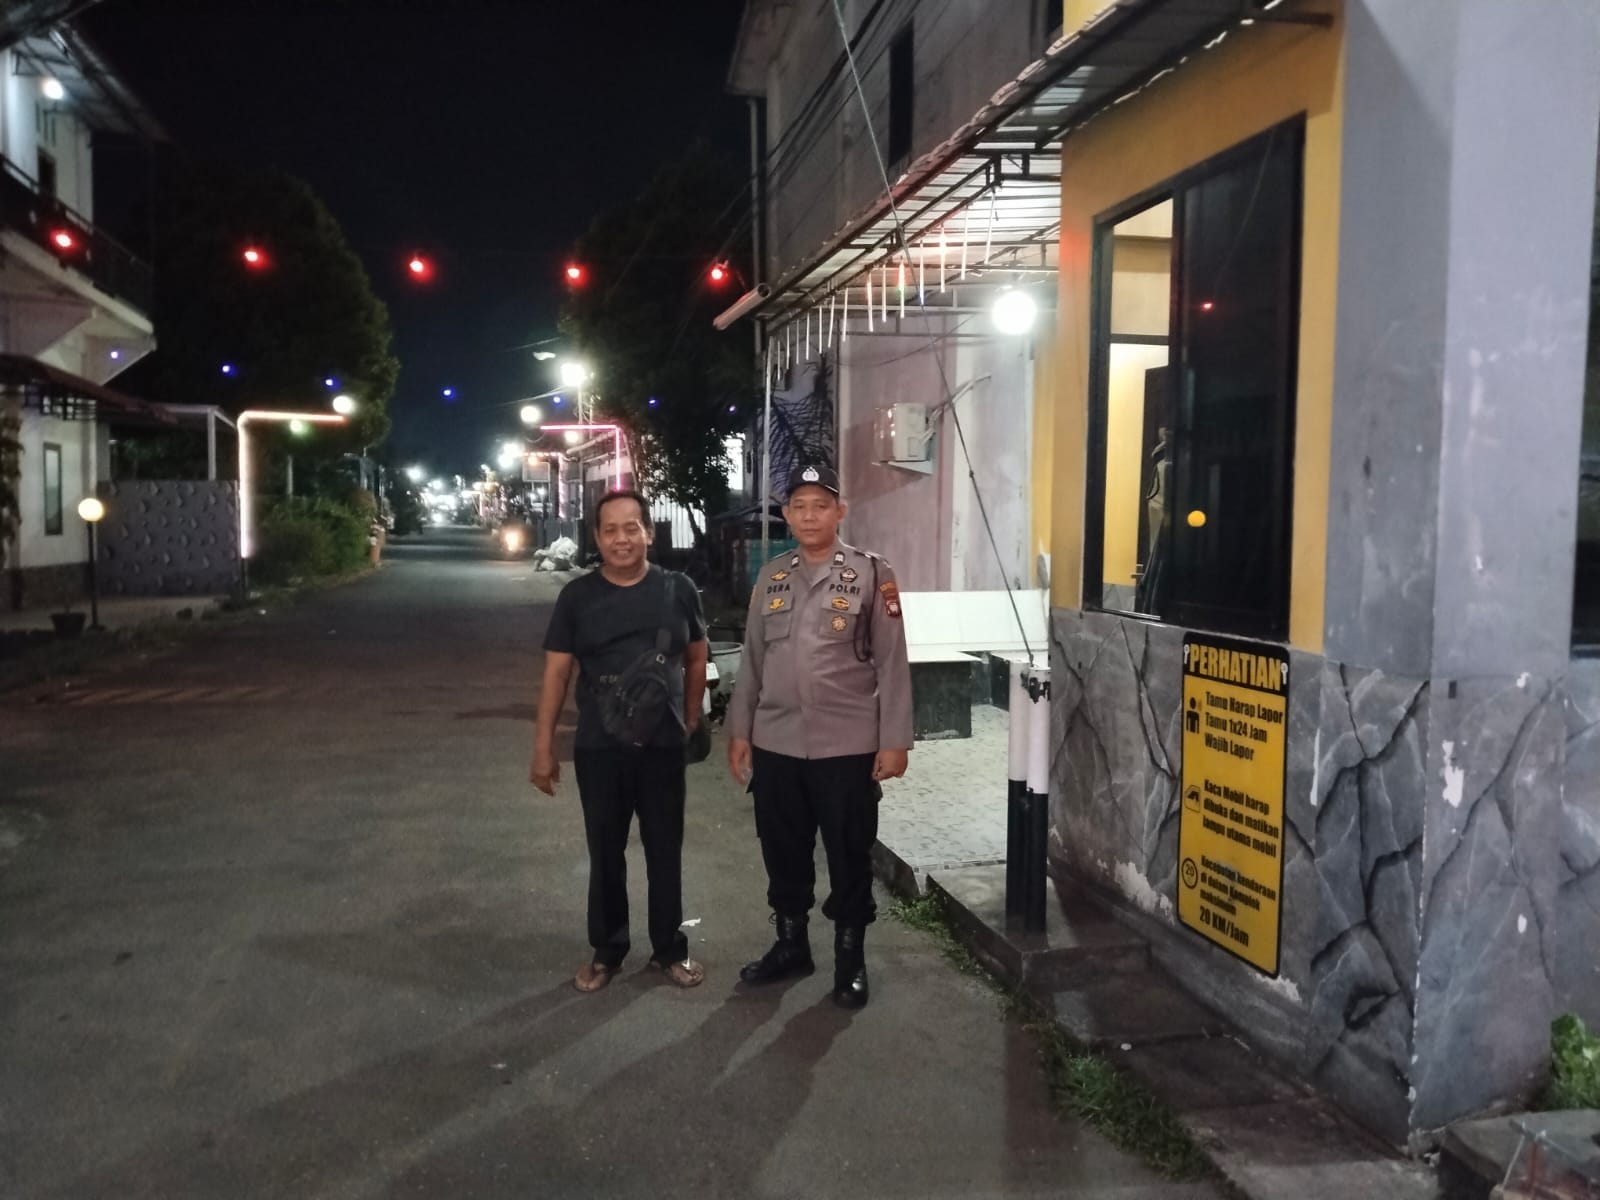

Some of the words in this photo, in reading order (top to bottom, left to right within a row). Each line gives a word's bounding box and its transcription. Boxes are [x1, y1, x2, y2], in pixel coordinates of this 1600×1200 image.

[767, 584, 790, 595] DERA
[829, 584, 861, 596] POLRI
[1190, 643, 1281, 691] PERHATIAN
[1206, 691, 1228, 710] Tamu
[1229, 697, 1255, 718] Harap
[1257, 704, 1283, 725] Lapor
[1205, 712, 1227, 731] Tamu
[1229, 718, 1248, 737] 1x24
[1249, 725, 1267, 743] Jam
[1204, 732, 1228, 753] Wajib
[1230, 740, 1254, 761] Lapor
[1204, 779, 1221, 797] Kaca
[1223, 786, 1244, 806] Mobil
[1245, 794, 1269, 815] harap
[1203, 798, 1228, 818] dibuka
[1229, 808, 1244, 825] dan
[1245, 815, 1279, 839] matikan
[1226, 827, 1251, 847] utama
[1252, 838, 1276, 858] mobil
[1237, 872, 1276, 901] kendaraan
[1199, 905, 1211, 926] 20
[1211, 912, 1249, 948] KM/Jam
